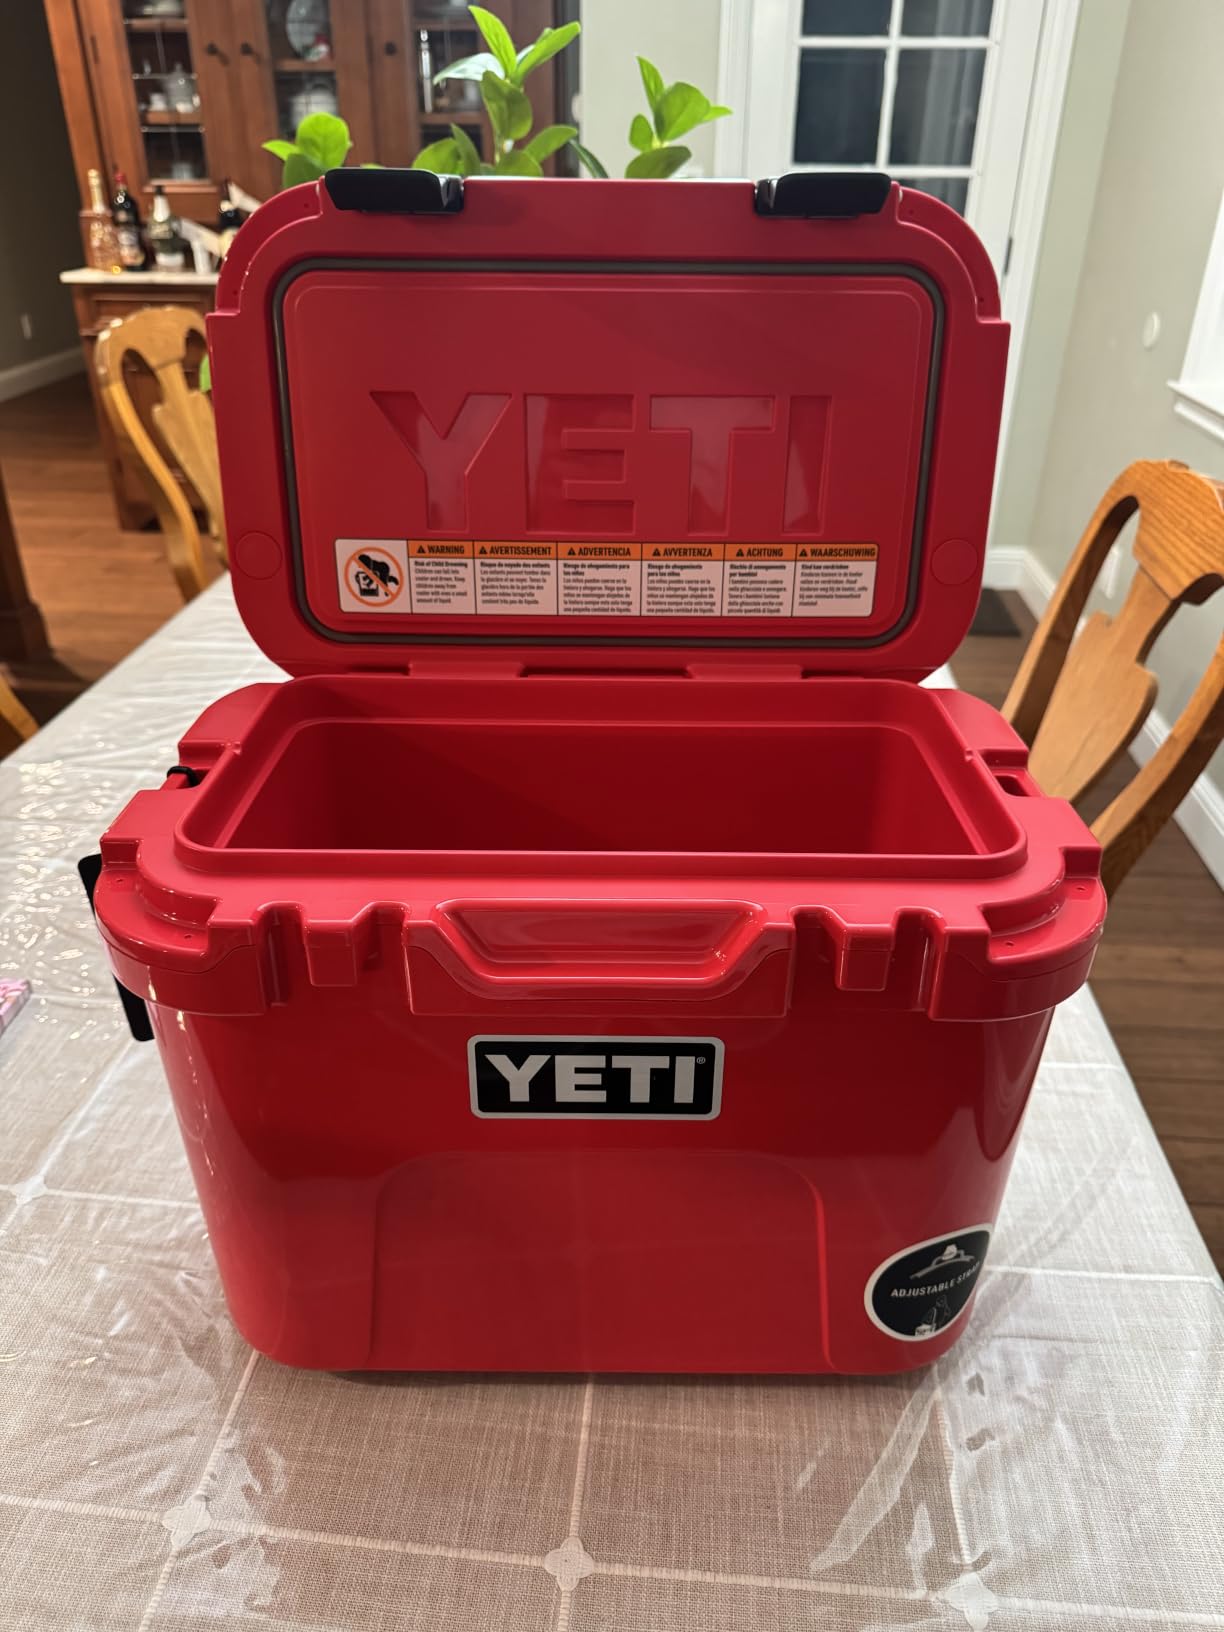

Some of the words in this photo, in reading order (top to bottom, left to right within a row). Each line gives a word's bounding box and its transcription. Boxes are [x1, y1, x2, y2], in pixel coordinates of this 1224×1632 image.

[369, 390, 832, 536] YETI
[428, 545, 464, 554] WARNING
[490, 546, 552, 556] AVERTISSEMENT
[578, 547, 631, 556] ADVERTENCIA
[663, 548, 712, 557] AVVERTENZA
[746, 548, 783, 557] ACHTUNG
[810, 548, 876, 557] WAARSCHUWING
[890, 1278, 955, 1297] ADJUSTABLE
